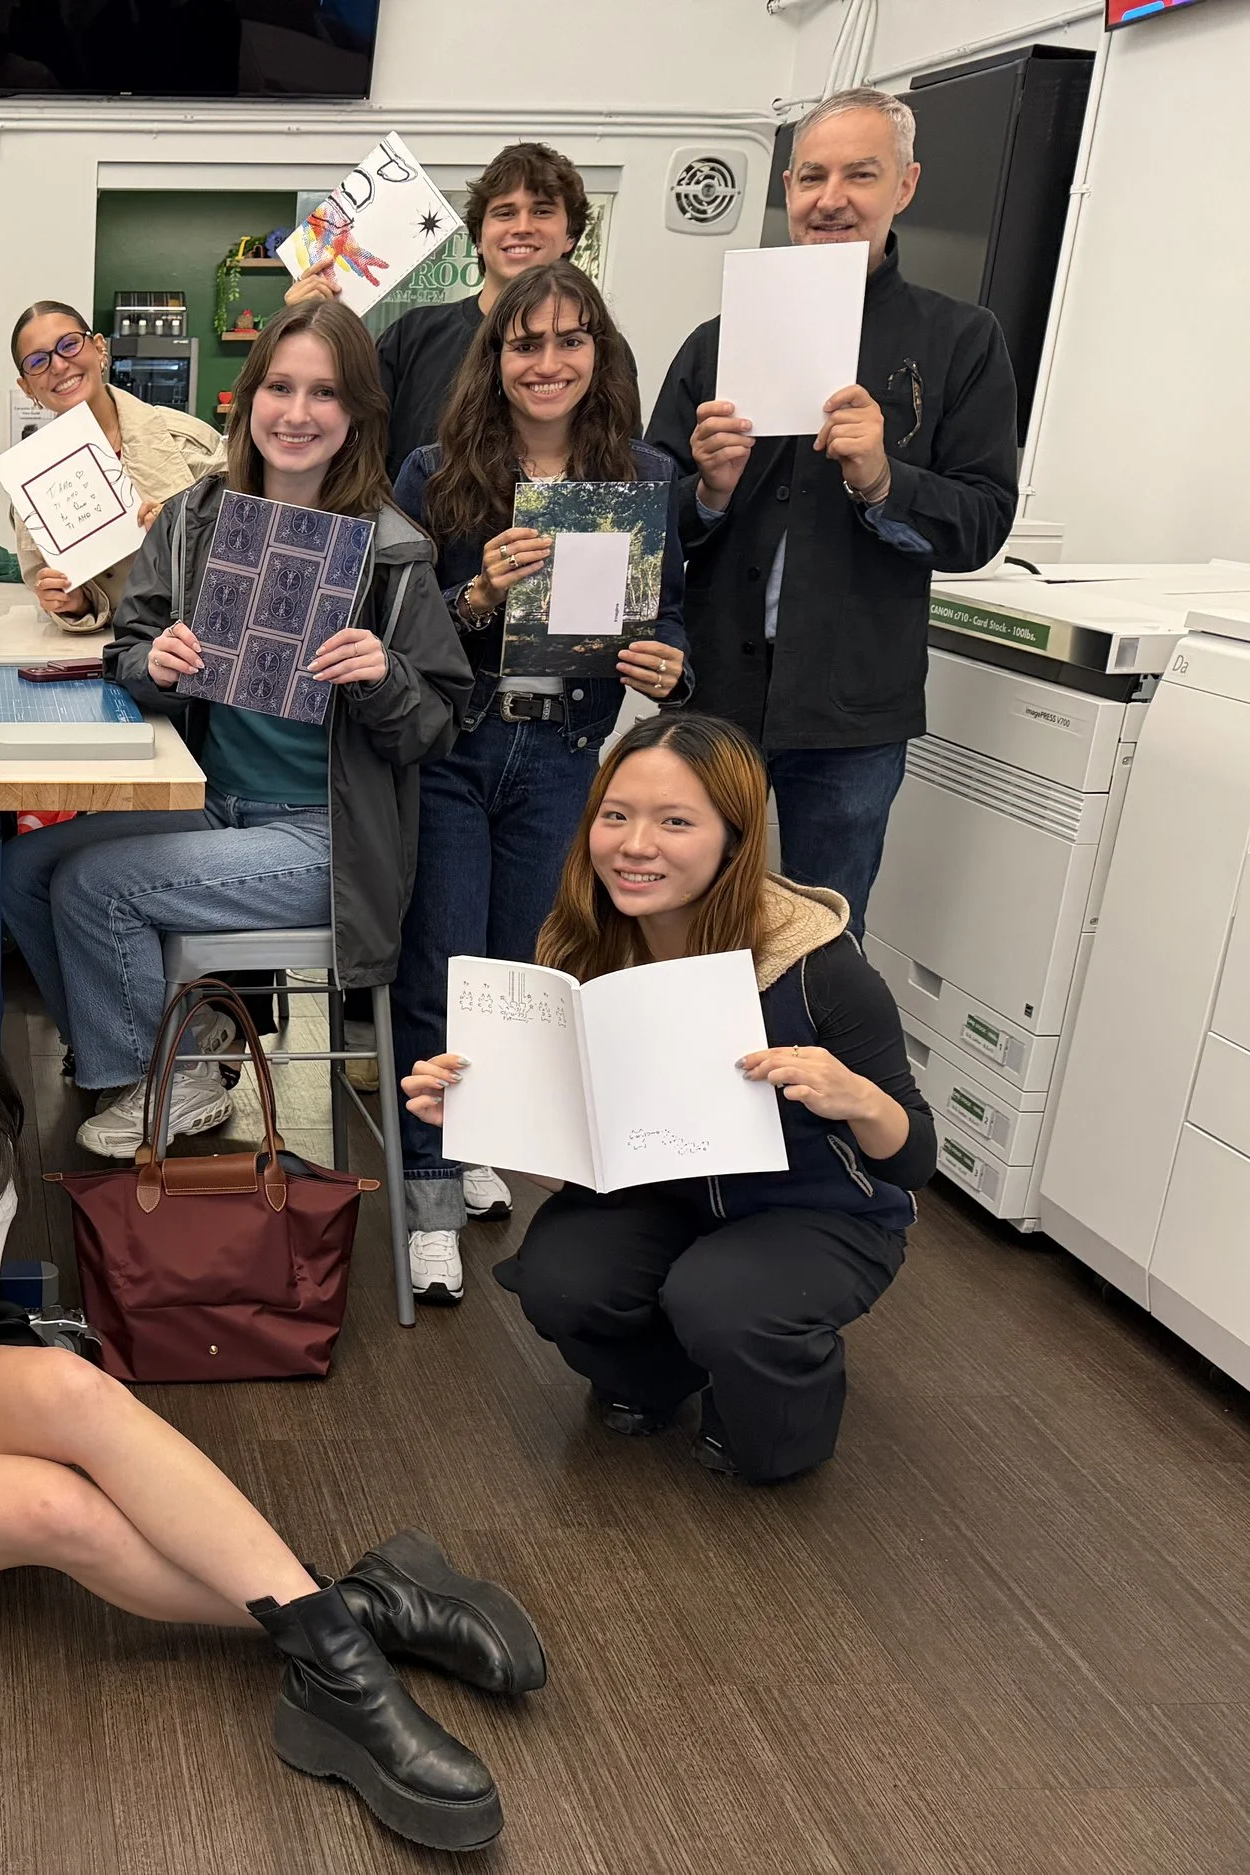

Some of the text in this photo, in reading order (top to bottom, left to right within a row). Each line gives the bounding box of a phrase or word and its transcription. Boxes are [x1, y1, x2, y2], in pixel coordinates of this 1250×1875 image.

[409, 260, 487, 289] ROO
[930, 604, 953, 619] CANON
[954, 611, 969, 622] c710
[973, 615, 989, 628] Card
[990, 620, 1008, 633] Stock
[1013, 626, 1037, 641] 100lbs.
[1172, 654, 1190, 673] Da
[1057, 716, 1071, 728] V700
